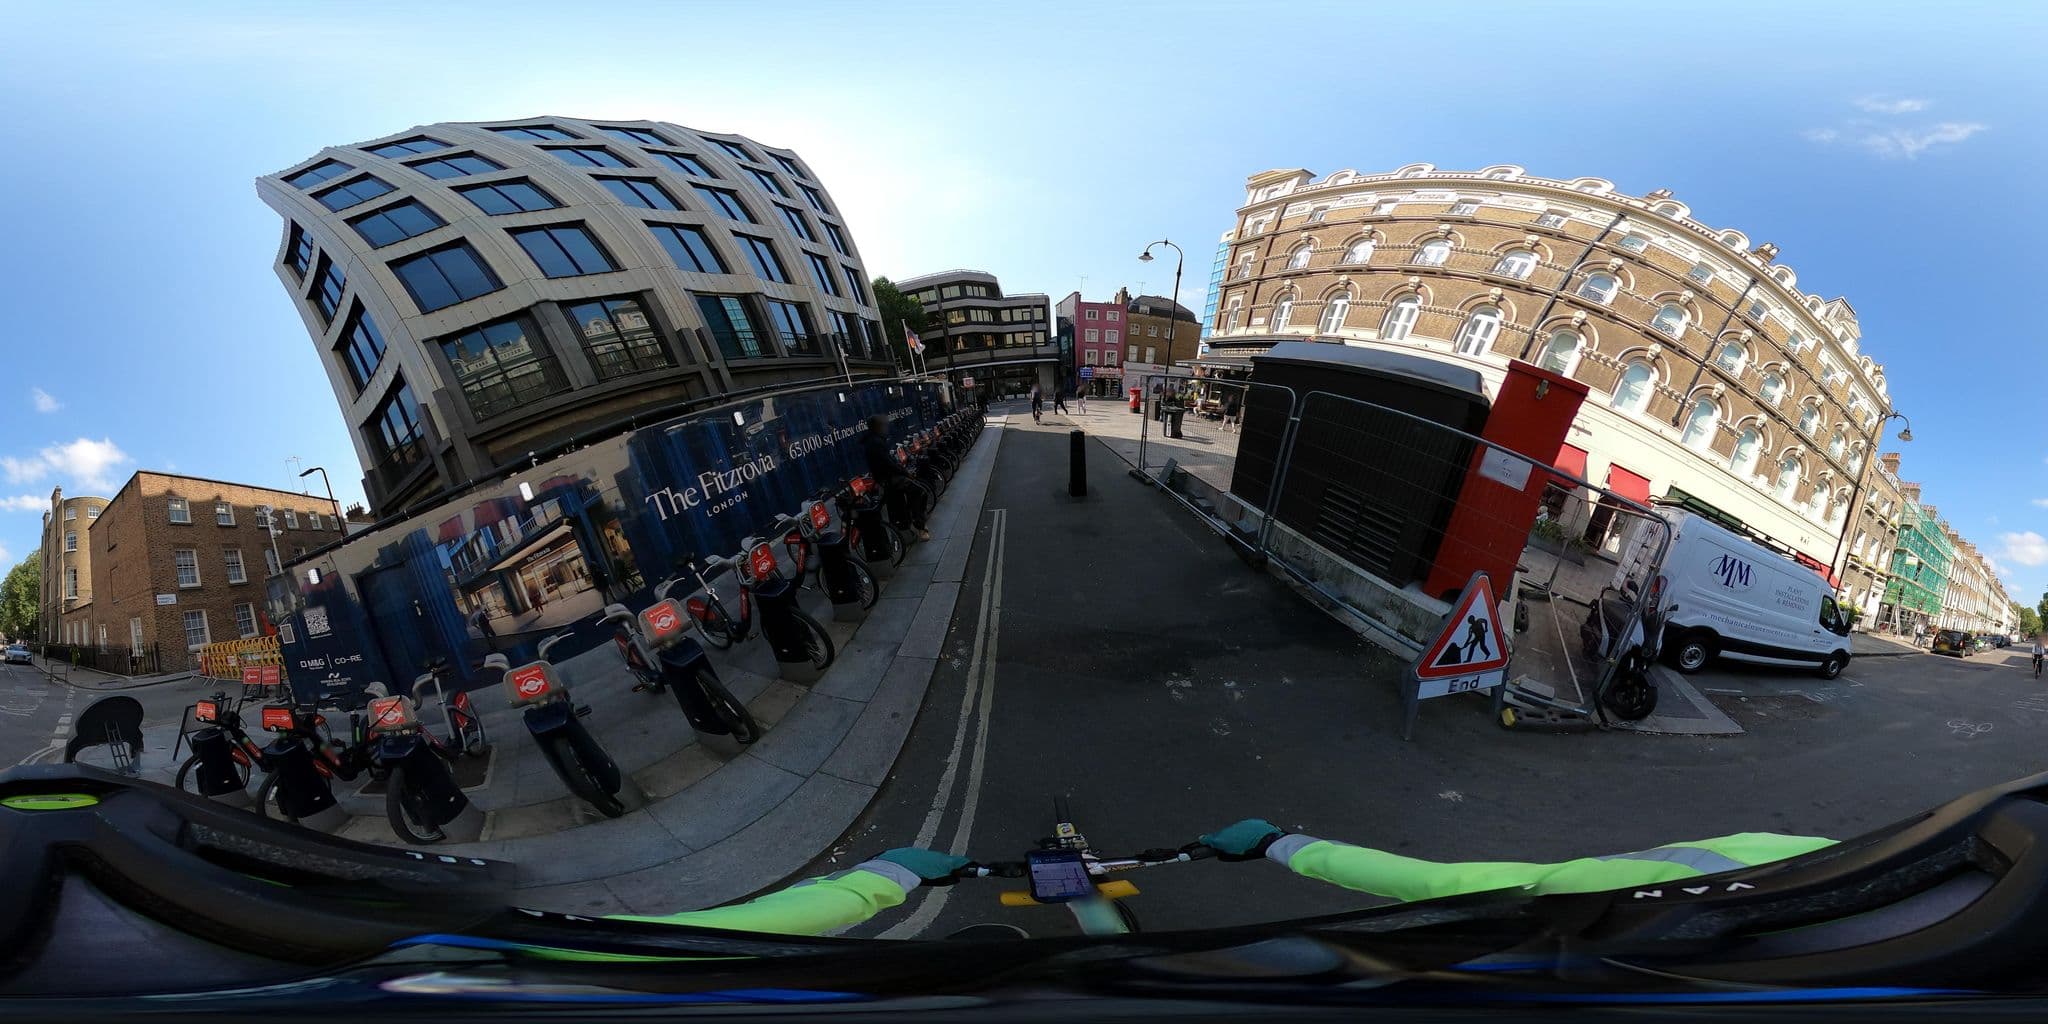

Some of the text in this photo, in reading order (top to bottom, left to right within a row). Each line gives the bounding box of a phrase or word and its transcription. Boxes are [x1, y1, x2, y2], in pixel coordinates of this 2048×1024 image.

[789, 434, 822, 459] 65,000
[823, 434, 834, 447] sq
[645, 453, 775, 520] The Fitzrovia
[706, 491, 749, 517] LONDON
[1714, 554, 1751, 588] MM
[1448, 675, 1480, 693] End
